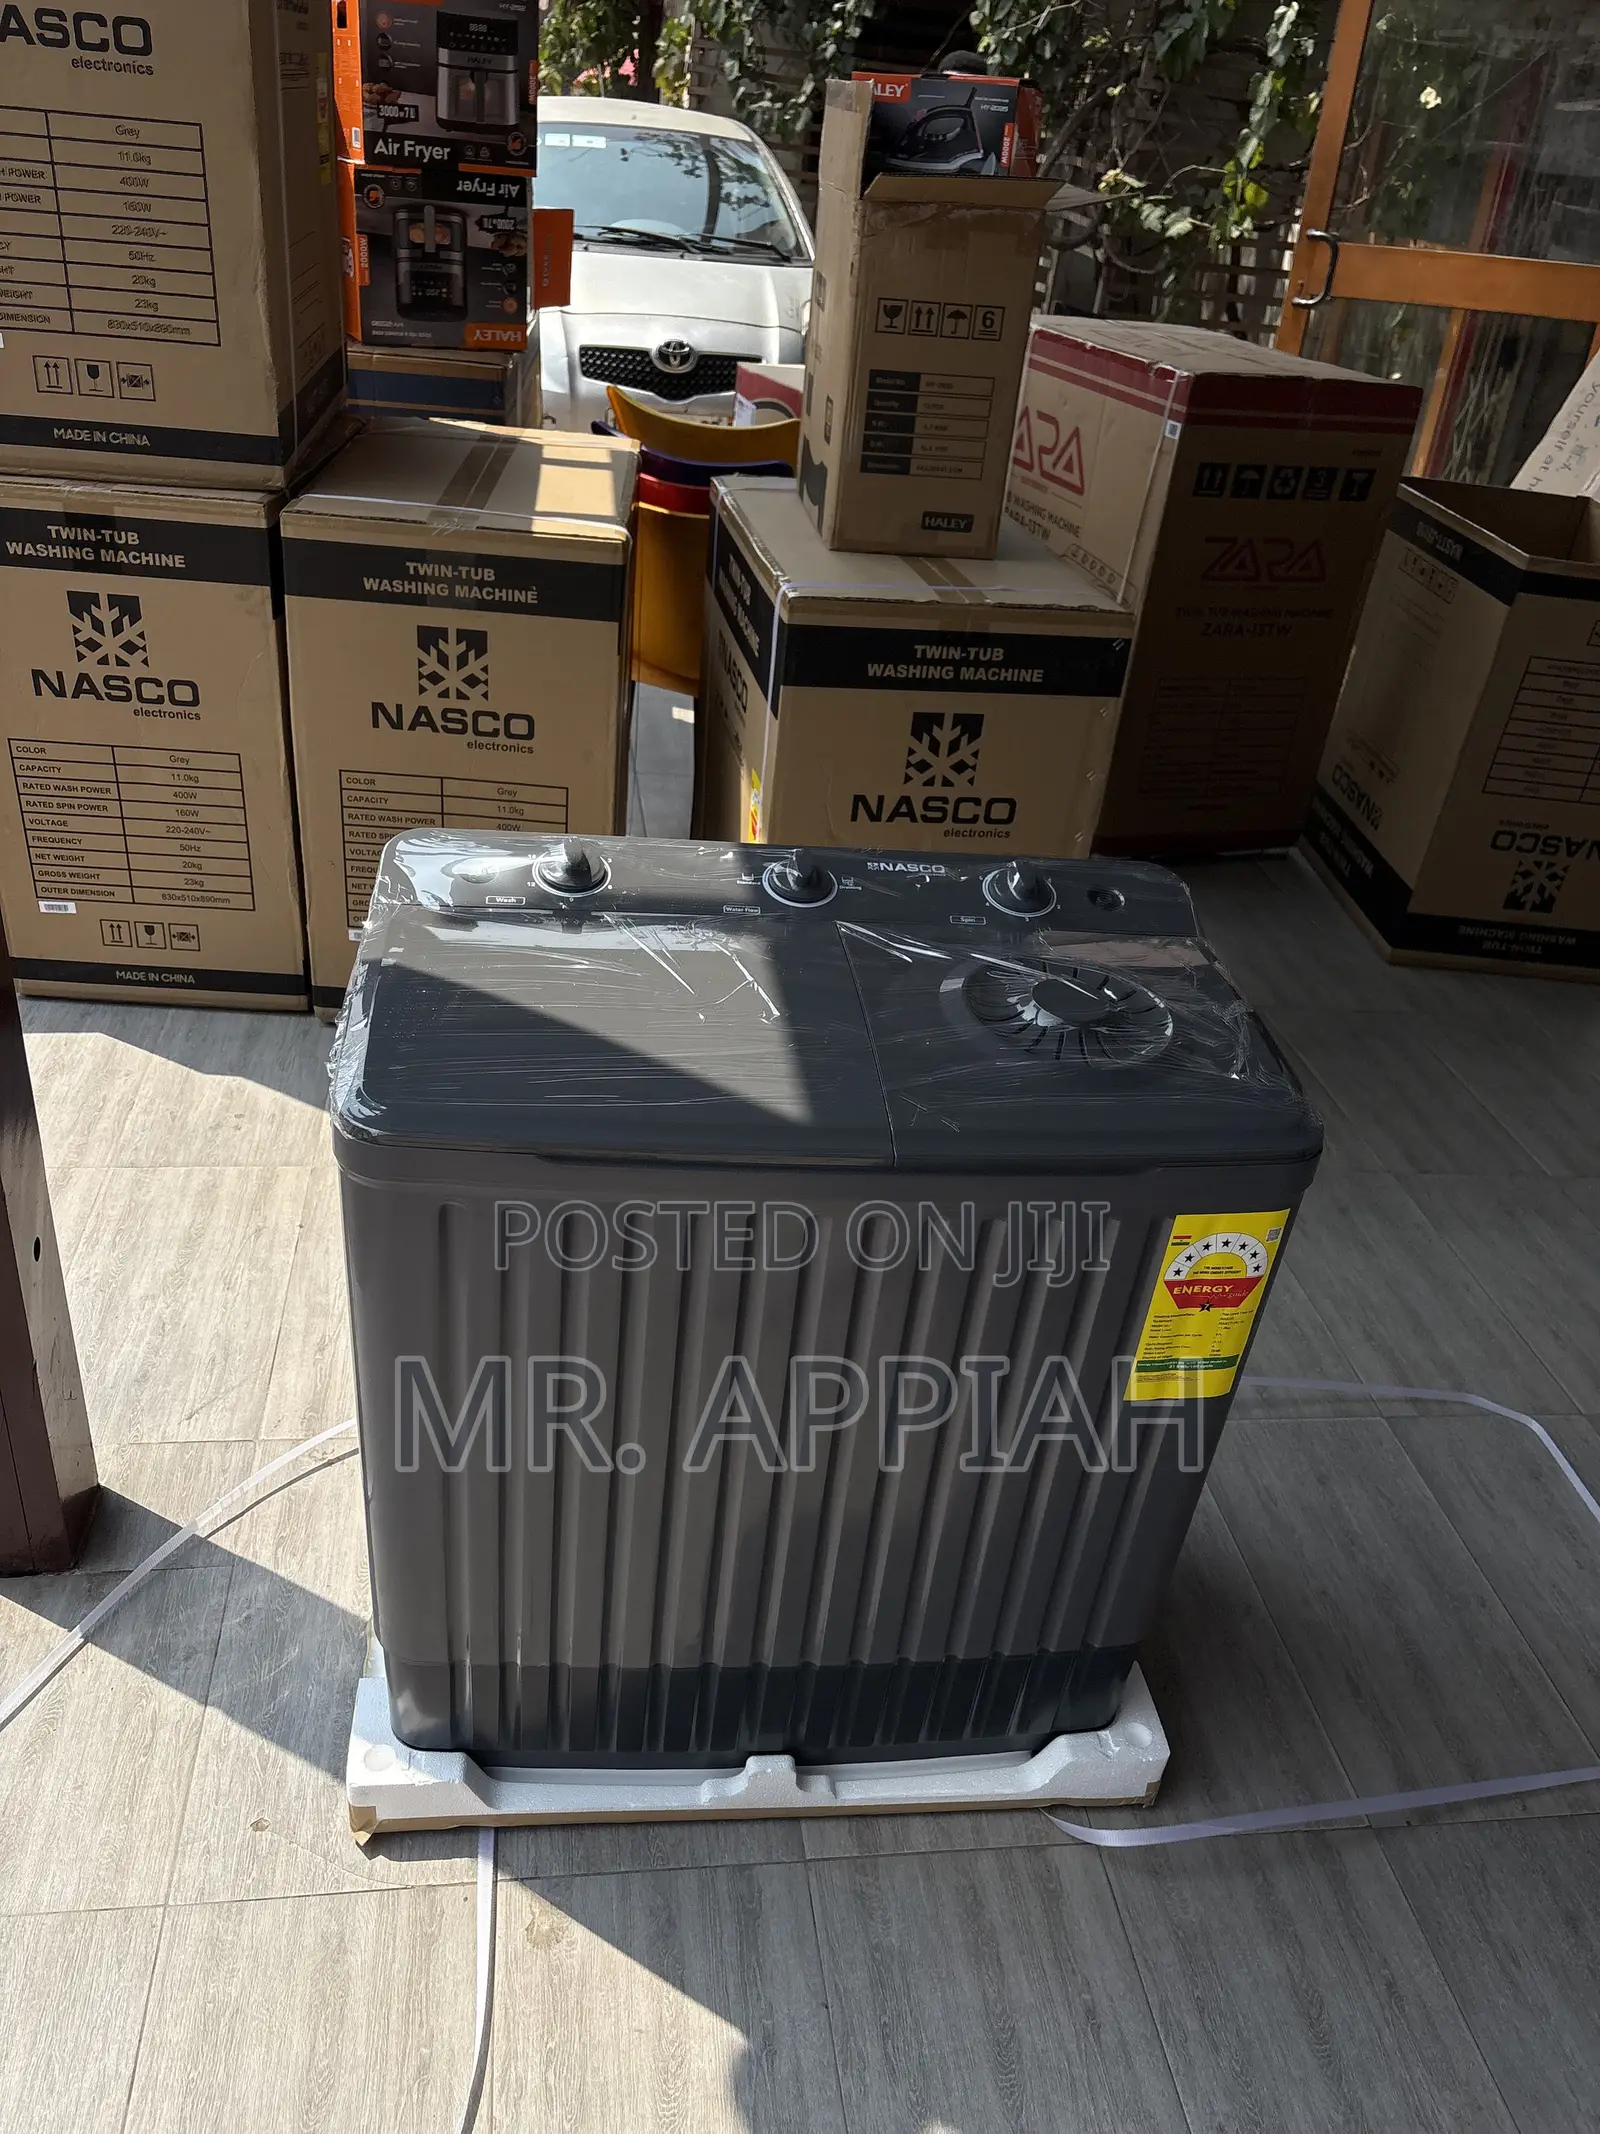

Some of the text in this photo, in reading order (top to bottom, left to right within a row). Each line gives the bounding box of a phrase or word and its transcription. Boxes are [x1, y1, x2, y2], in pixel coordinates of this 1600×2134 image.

[71, 55, 154, 76] electronics
[115, 124, 140, 140] Grey
[374, 138, 451, 163] Air Fryer
[1001, 137, 1011, 164] 2000W
[117, 151, 151, 166] 11.0kg
[8, 168, 149, 189] POWER 400W
[456, 178, 521, 199] Air Fryer
[4, 192, 152, 214] POWER 160W
[128, 250, 156, 263] 50Hz
[132, 274, 156, 289] 20kg
[134, 298, 159, 312] 23kg
[981, 310, 995, 330] 6
[472, 327, 523, 343] HALEY
[53, 427, 151, 447] MADE IN CHINA
[924, 515, 969, 530] HALEY
[47, 525, 140, 545] TWIN-TUB
[5, 541, 187, 569] WASHING MACHINE
[1201, 536, 1328, 583] ZARA
[405, 561, 496, 582] TWIN-TUB
[363, 576, 539, 604] WASHING MACHINE
[914, 644, 1005, 662] TWIN-TUB
[867, 663, 1045, 684] WASHING MACHINE
[31, 669, 201, 707] NASCO
[133, 707, 202, 721] electronics
[371, 701, 535, 741] NASCO
[15, 745, 48, 756] COLOR
[466, 740, 535, 755] electronics
[169, 754, 191, 766] Grey
[19, 764, 63, 775] CAPACITY
[171, 773, 200, 785] 11.0kg
[346, 776, 377, 787] COLOR
[22, 782, 113, 796] RATED WASH POWER
[172, 791, 198, 801] 400W
[496, 787, 518, 798] Grey
[25, 800, 109, 813] RATED SPIN POWER
[346, 795, 390, 806] CAPACITY
[175, 809, 201, 818] 160W
[496, 805, 525, 818] 11.0kg
[850, 794, 1018, 825] NASCO
[28, 818, 70, 828] VOLTAGE
[347, 812, 437, 827] RATED WASH POWER
[165, 825, 212, 837] 220-240V~
[496, 823, 522, 832] 400W
[943, 828, 1012, 839] electronics
[31, 835, 84, 847] FREQUENCY
[348, 830, 378, 840] RATED
[179, 843, 202, 853] 50Hz
[34, 852, 86, 863] NET WEIGHT
[182, 860, 204, 872] 20kg
[880, 861, 946, 874] NASCO
[38, 869, 102, 881] GROSS WEIGHT
[183, 877, 206, 889] 23kg
[351, 882, 368, 891] NET
[40, 886, 116, 898] OUTER DIMENSION
[496, 896, 518, 905] Wash
[959, 916, 977, 925] Spin
[1456, 924, 1516, 941] MACHINE
[115, 970, 197, 985] MADE IN CHINA
[1173, 1284, 1234, 1296] ENERGY
